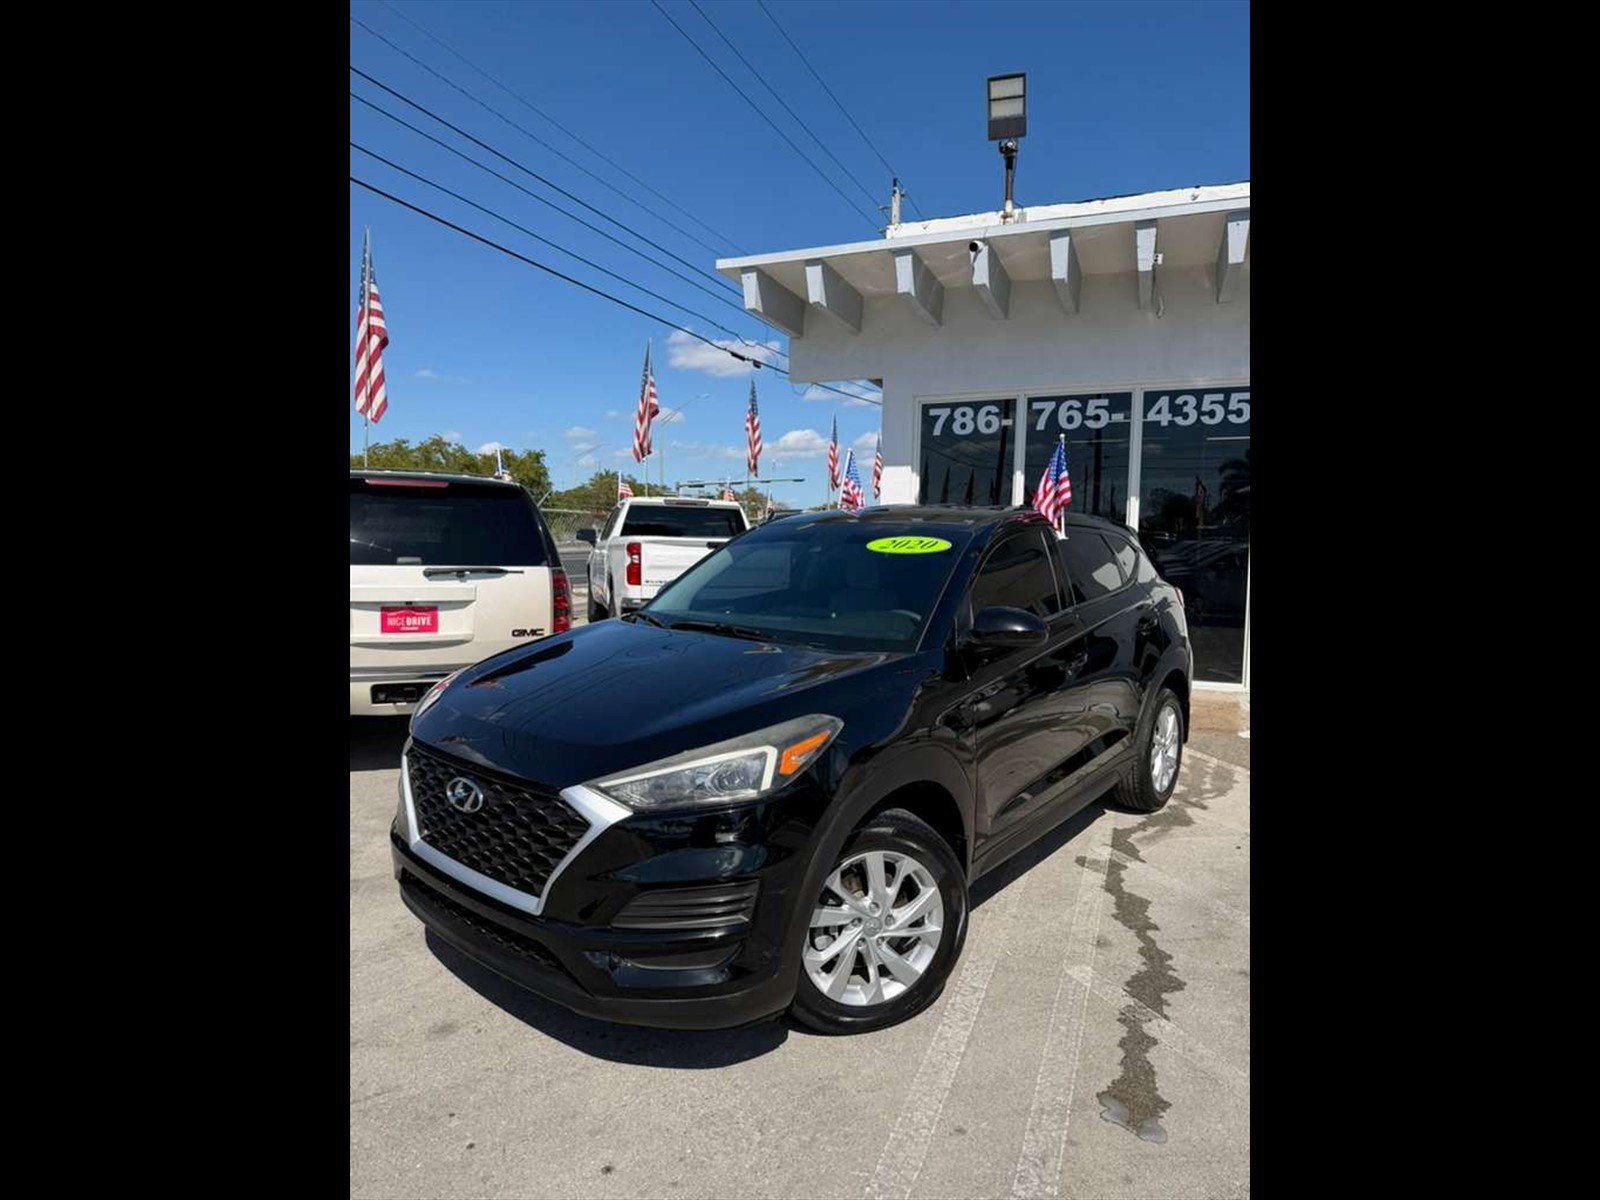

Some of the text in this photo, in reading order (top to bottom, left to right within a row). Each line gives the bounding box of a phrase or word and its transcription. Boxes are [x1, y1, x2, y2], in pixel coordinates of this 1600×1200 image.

[929, 392, 1250, 436] 786- 765- 4355
[879, 539, 939, 550] 2020
[511, 628, 545, 637] GMC
